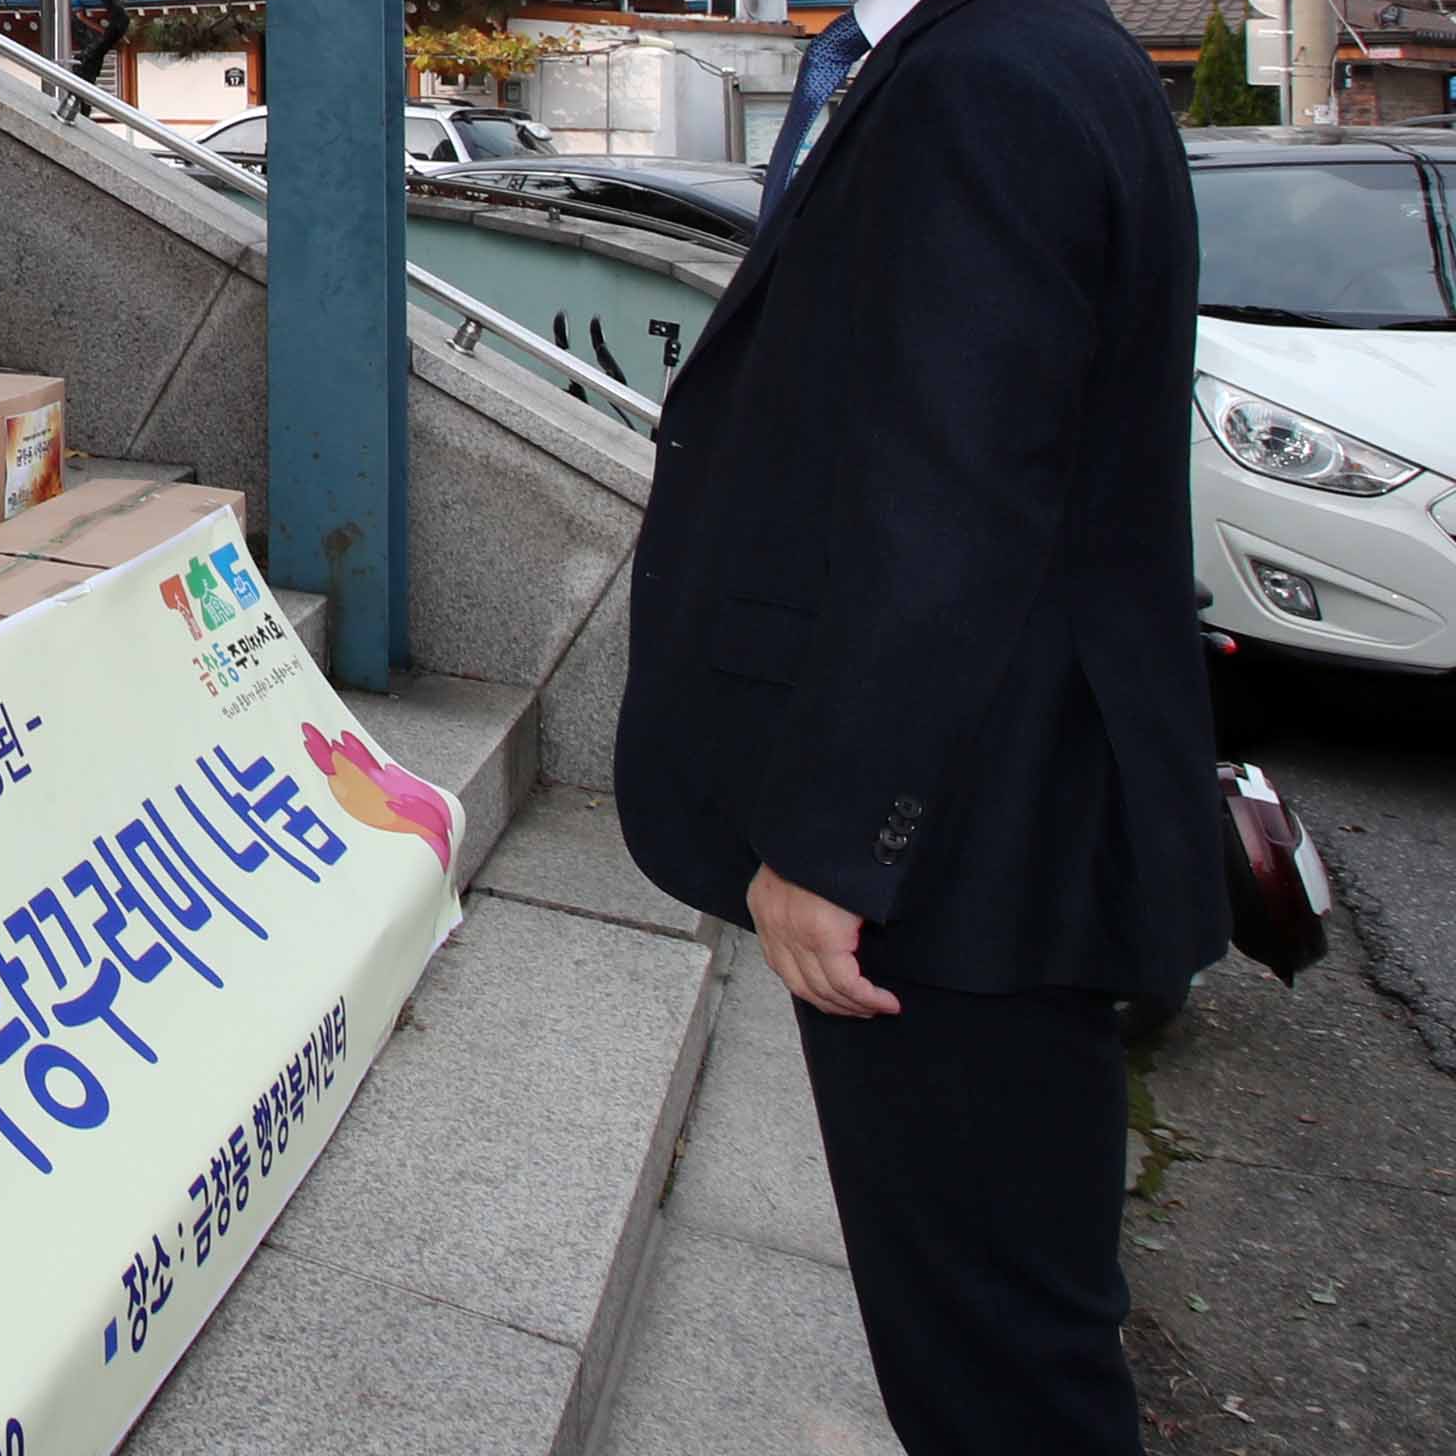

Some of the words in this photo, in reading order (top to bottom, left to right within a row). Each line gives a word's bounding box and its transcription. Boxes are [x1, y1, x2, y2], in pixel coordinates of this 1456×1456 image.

[176, 745, 348, 884] 나눔
[188, 1124, 252, 1268] 금창동
[252, 995, 348, 1178] 행정복지센터
